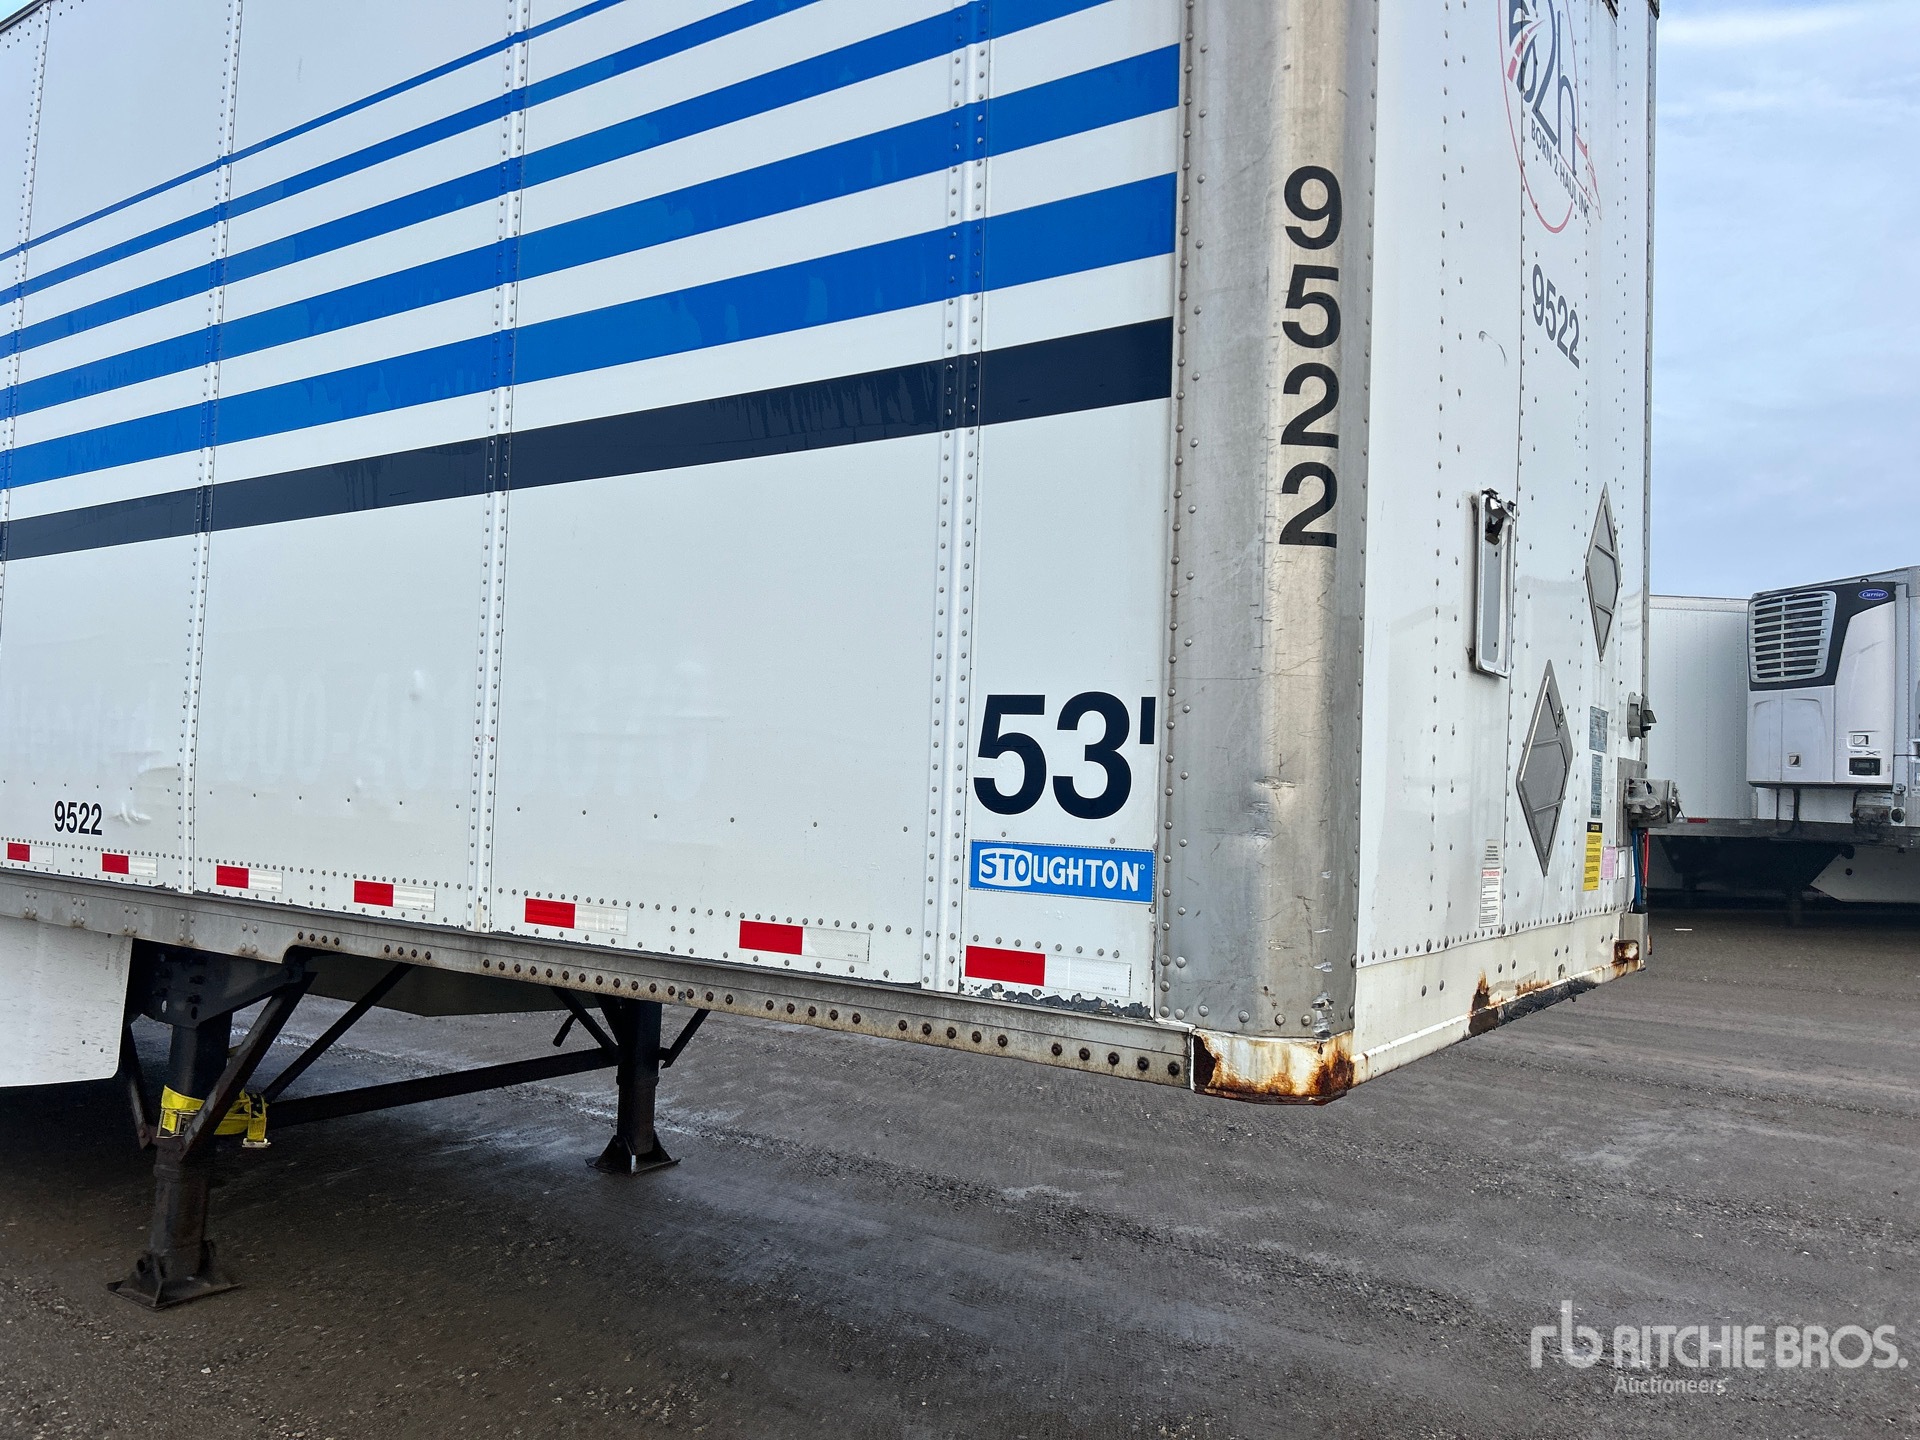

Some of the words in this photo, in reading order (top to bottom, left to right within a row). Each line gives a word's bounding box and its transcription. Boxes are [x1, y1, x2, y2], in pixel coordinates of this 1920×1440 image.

[1530, 117, 1552, 167] BORN
[1553, 153, 1559, 177] 2
[1560, 162, 1578, 206] HAUL
[1532, 263, 1580, 370] 9522
[54, 800, 103, 836] 9522
